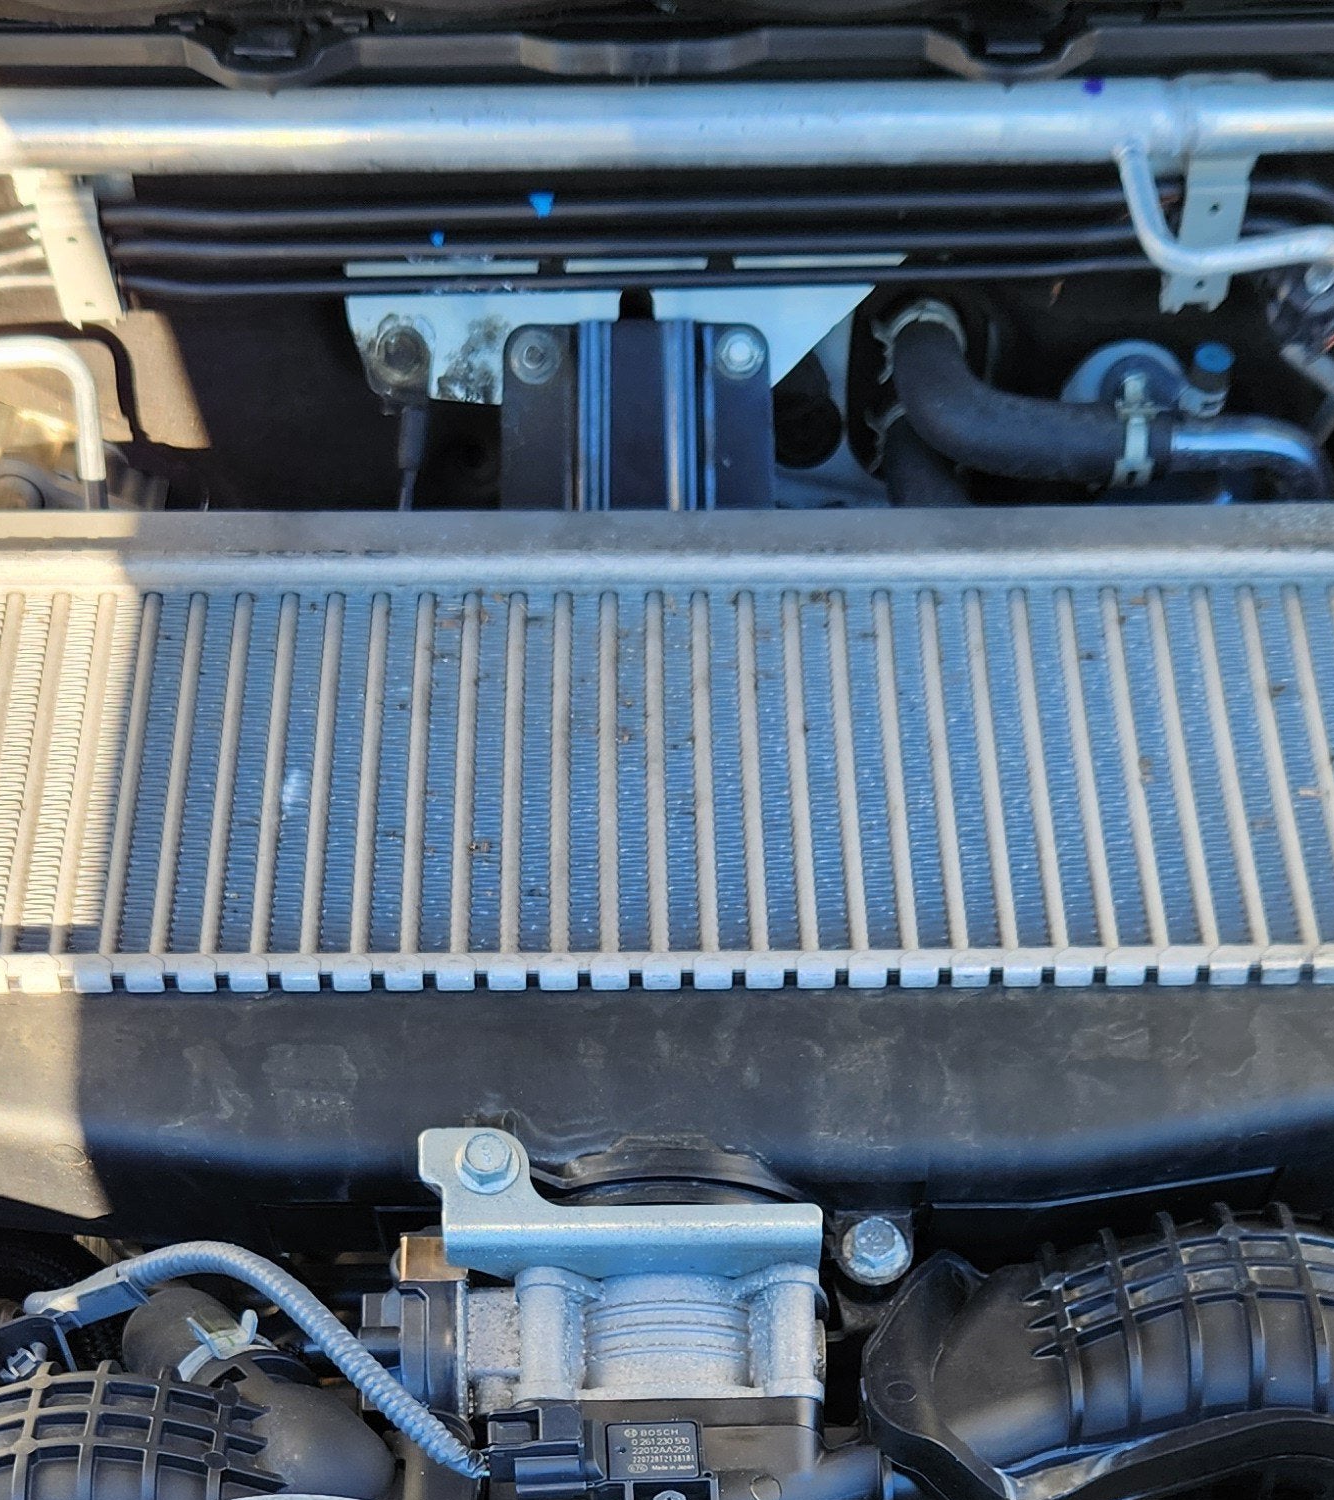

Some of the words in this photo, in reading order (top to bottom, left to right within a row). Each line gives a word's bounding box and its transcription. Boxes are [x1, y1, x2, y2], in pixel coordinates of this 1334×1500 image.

[639, 1428, 679, 1437] BOSCH
[632, 1445, 691, 1455] 22012AA250
[677, 1463, 695, 1471] Japan
